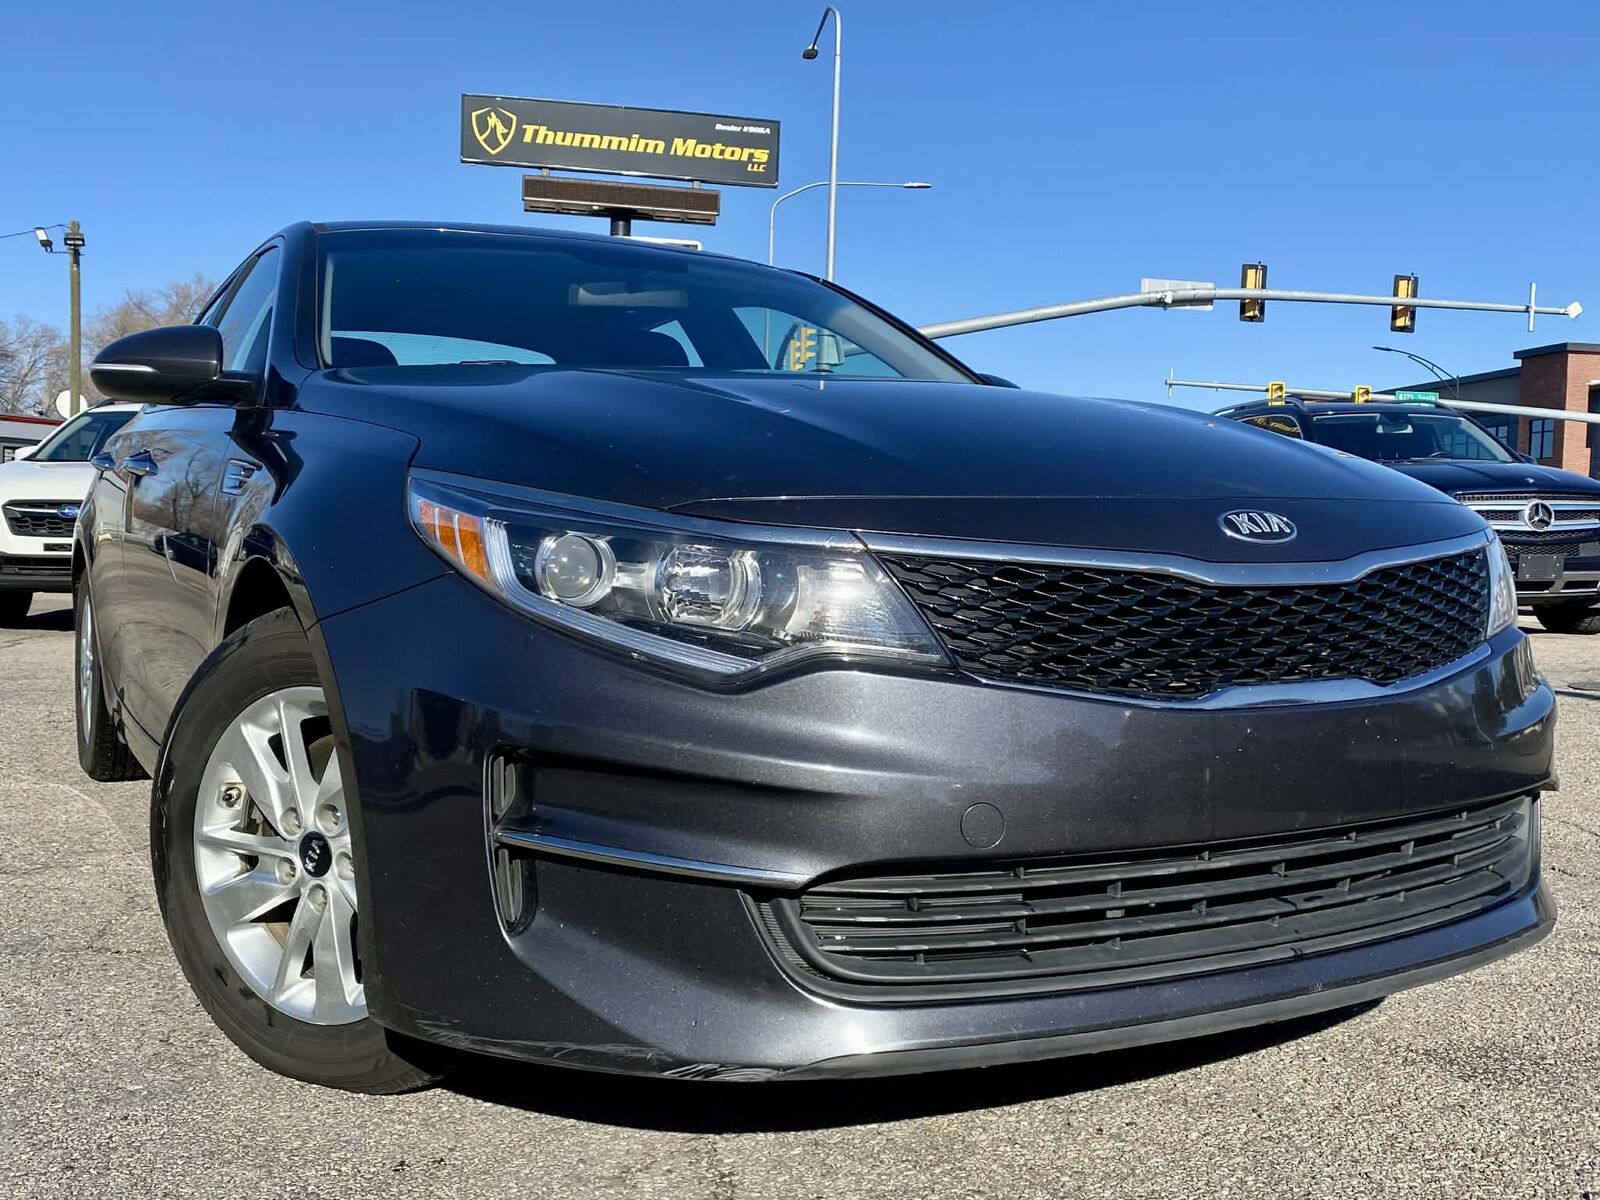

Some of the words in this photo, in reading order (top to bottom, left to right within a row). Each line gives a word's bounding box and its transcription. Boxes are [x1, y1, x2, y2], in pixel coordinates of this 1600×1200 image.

[715, 123, 742, 132] Dealer
[522, 124, 666, 154] Thummim
[670, 137, 770, 163] Motors
[747, 163, 767, 172] LLC
[1227, 512, 1291, 534] KIA
[304, 839, 324, 873] KIA
